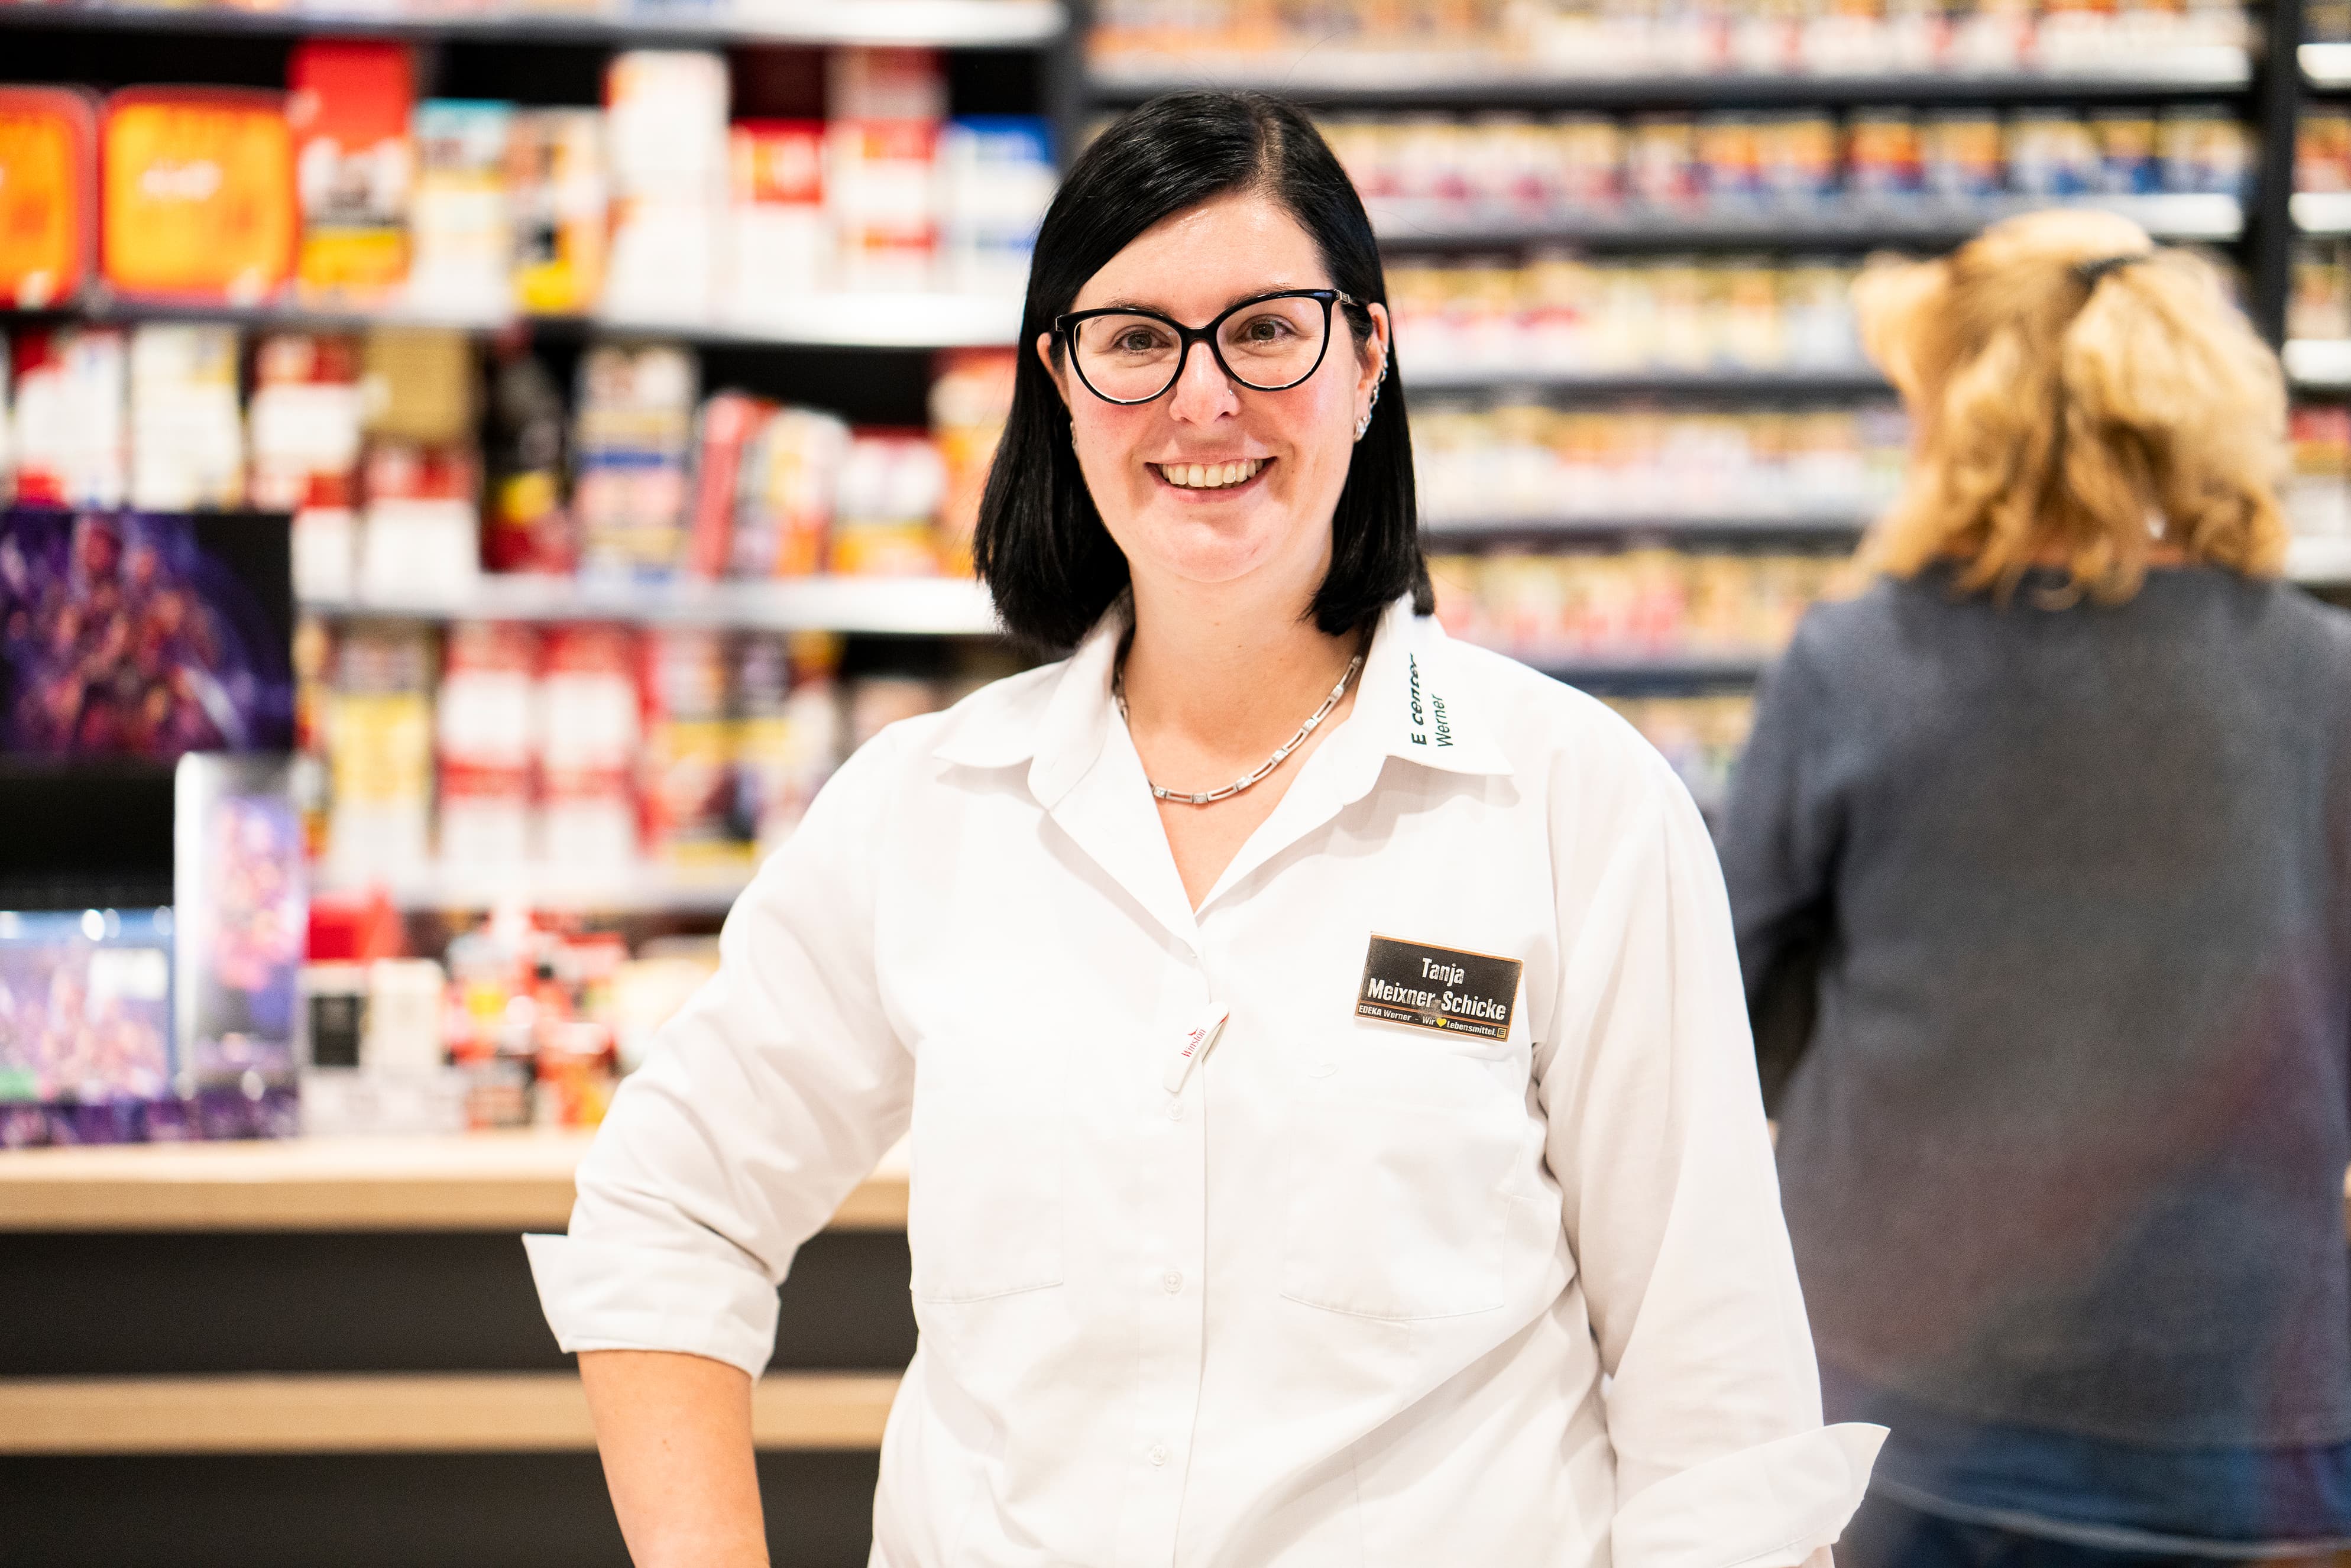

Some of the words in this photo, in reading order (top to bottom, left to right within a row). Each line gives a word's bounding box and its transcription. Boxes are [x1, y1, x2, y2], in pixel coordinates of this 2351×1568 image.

[1410, 652, 1424, 725] center
[1432, 694, 1453, 747] Werner
[1411, 733, 1427, 745] E
[1421, 957, 1465, 986] Tanja
[1367, 978, 1507, 1021] Meixner-Schicke
[1358, 1005, 1382, 1016] EDEKA
[1384, 1009, 1412, 1021] Werner
[1422, 1016, 1436, 1025] Wir
[1446, 1021, 1497, 1036] Lebensmittel.
[1181, 1029, 1206, 1057] Winston
